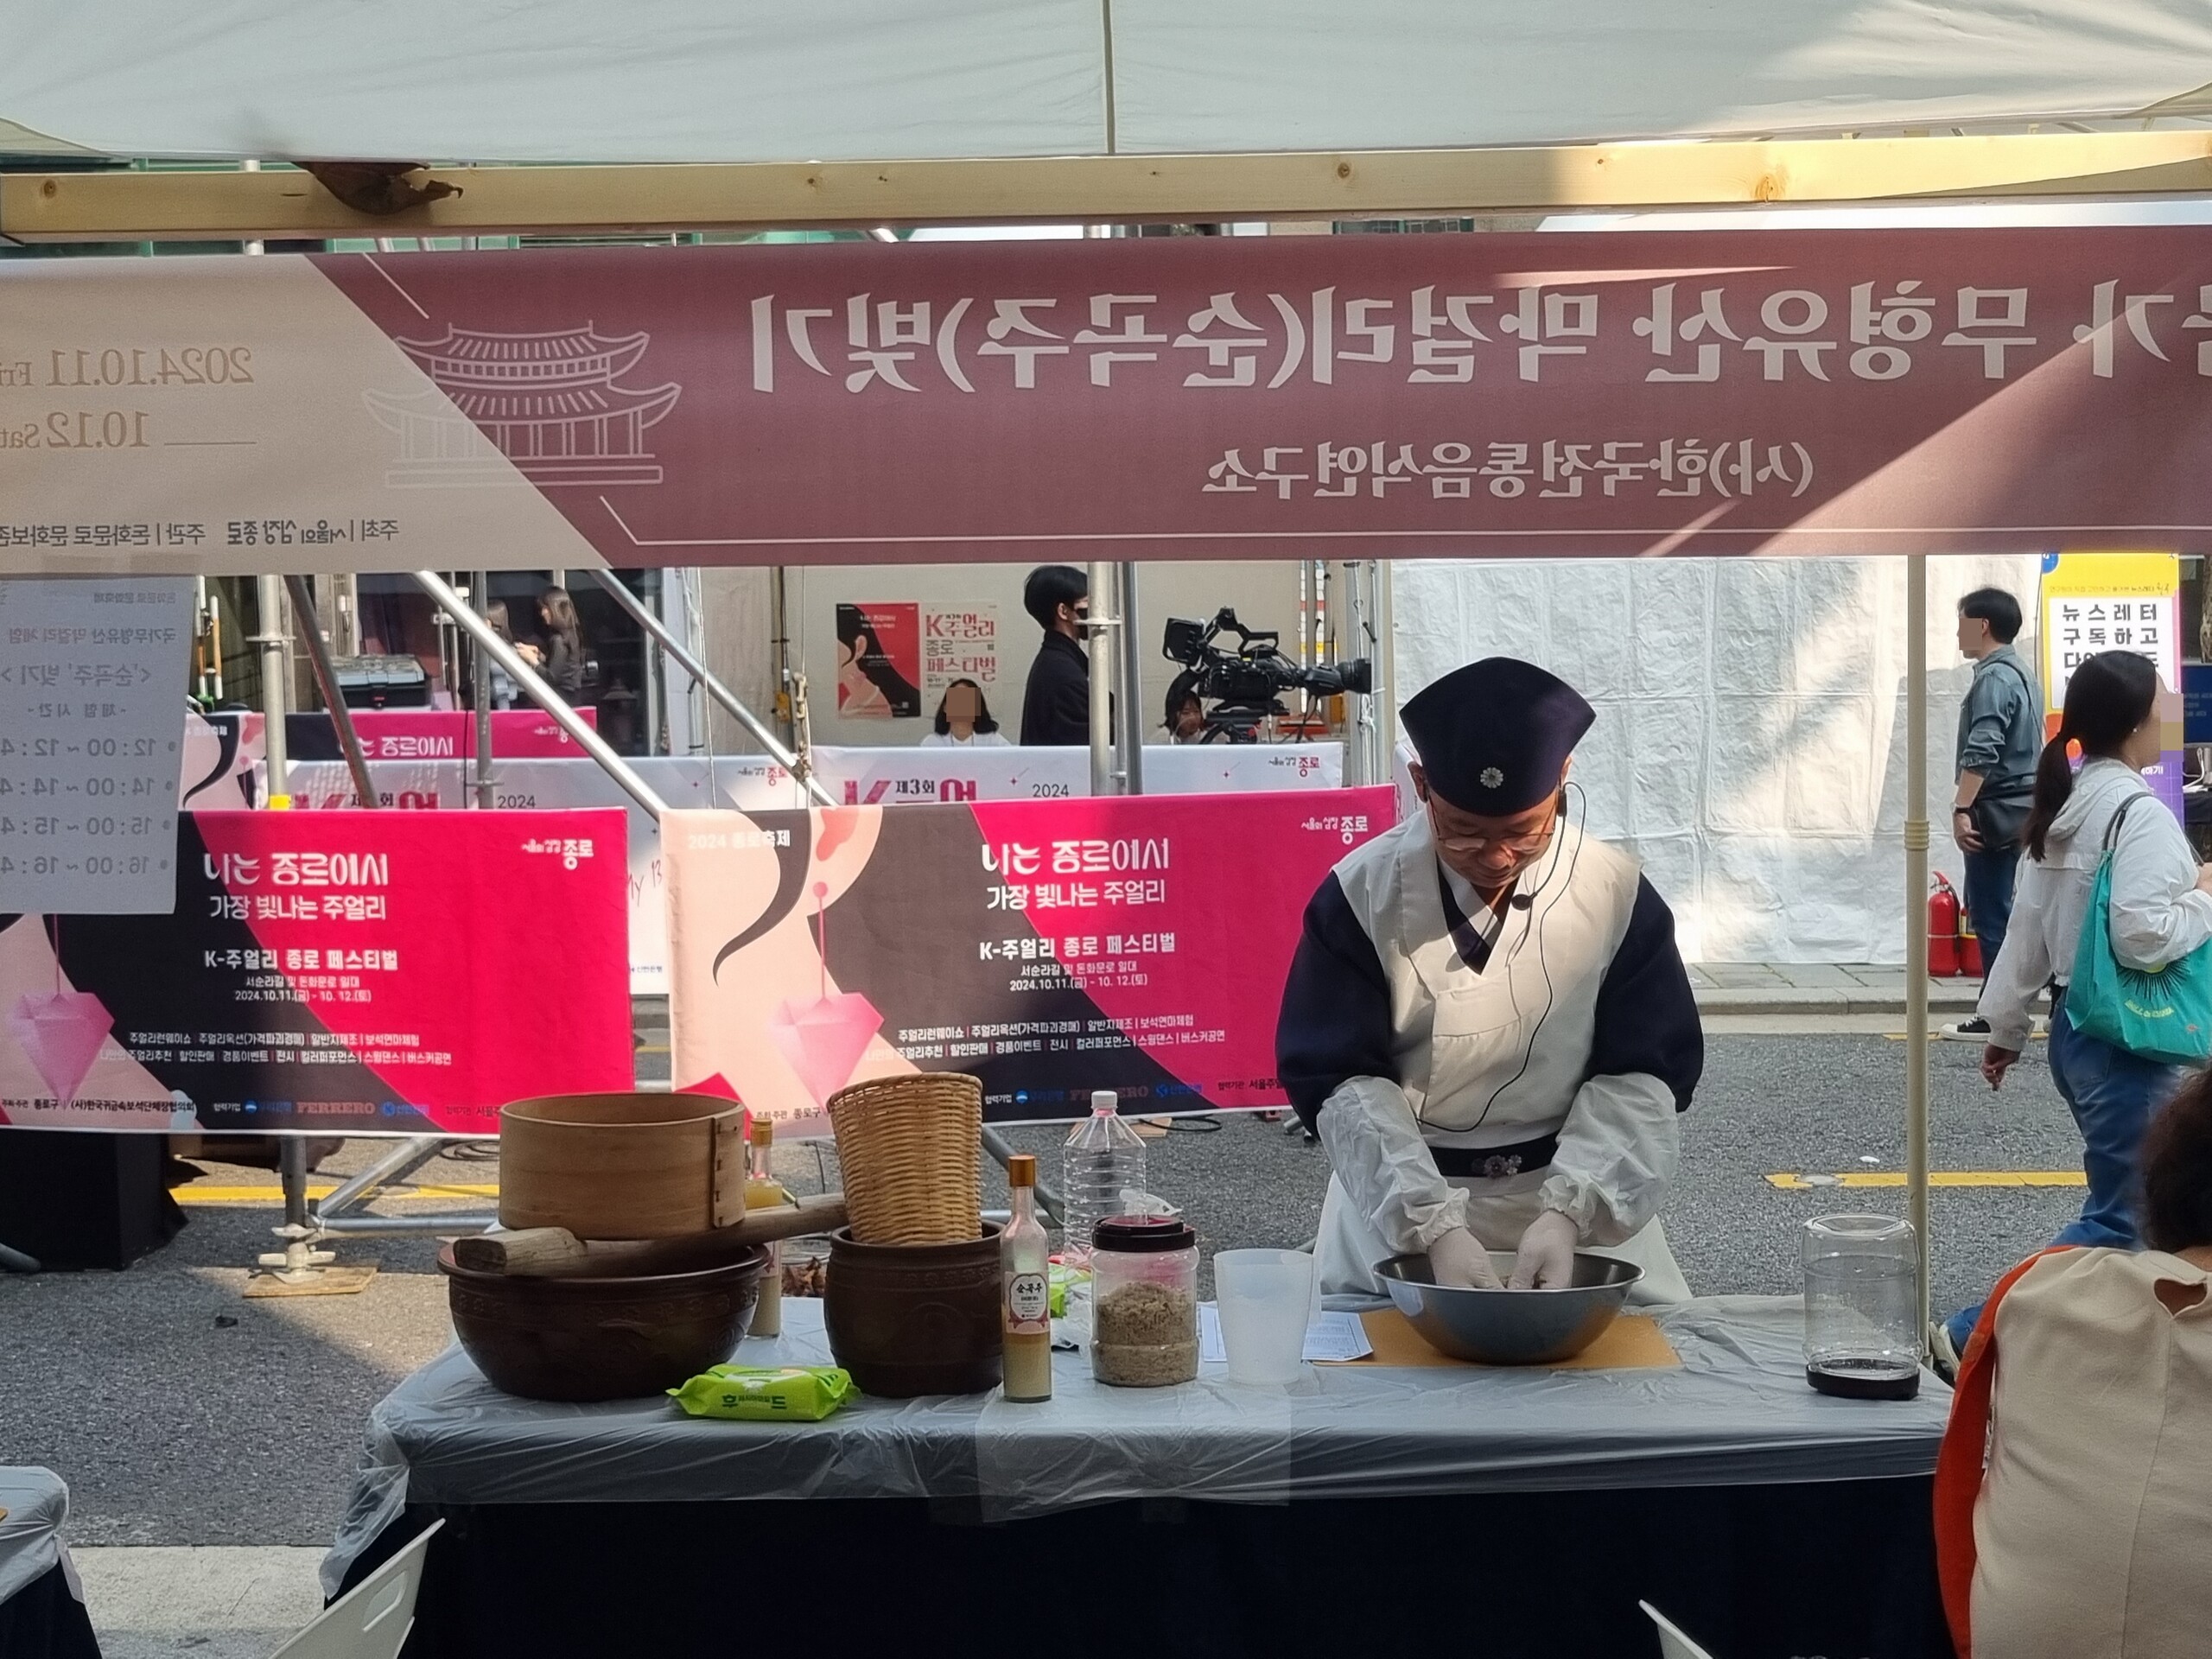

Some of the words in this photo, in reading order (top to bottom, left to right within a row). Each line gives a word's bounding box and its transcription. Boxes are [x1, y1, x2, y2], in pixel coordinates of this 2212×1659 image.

[2063, 604, 2158, 621] 뉴스레터
[2063, 628, 2158, 645] 구독하고
[926, 639, 954, 657] 종로
[1299, 757, 1319, 778] 종로
[895, 779, 935, 796] 제3회
[1032, 784, 1070, 798] 2024
[498, 794, 536, 809] 2024
[1340, 816, 1368, 845] 종로
[563, 839, 594, 870] 종로
[982, 842, 1040, 876] 나는
[1052, 837, 1169, 874] 종로에서
[204, 852, 260, 887] 나는
[987, 885, 1030, 911] 가장
[1035, 881, 1099, 910] 빛나는
[1103, 879, 1166, 906] 주얼리
[210, 895, 251, 920] 가장
[257, 895, 318, 920] 빛나는
[323, 895, 386, 920] 주얼리
[979, 938, 1056, 961] K-주얼리
[1063, 936, 1099, 958] 종로
[1106, 932, 1176, 956] 페스티벌
[204, 949, 277, 970] K-주얼리
[285, 949, 321, 970] 종로
[327, 949, 399, 971] 페스티벌
[1020, 963, 1060, 978] 서순라길
[1076, 961, 1116, 975] 돈화문로
[1118, 960, 1137, 972] 일대
[245, 975, 285, 988] 서순라길
[1050, 1039, 1068, 1052] 전시
[1070, 1085, 1149, 1102] FEERO
[296, 1101, 376, 1115] FERRERO
